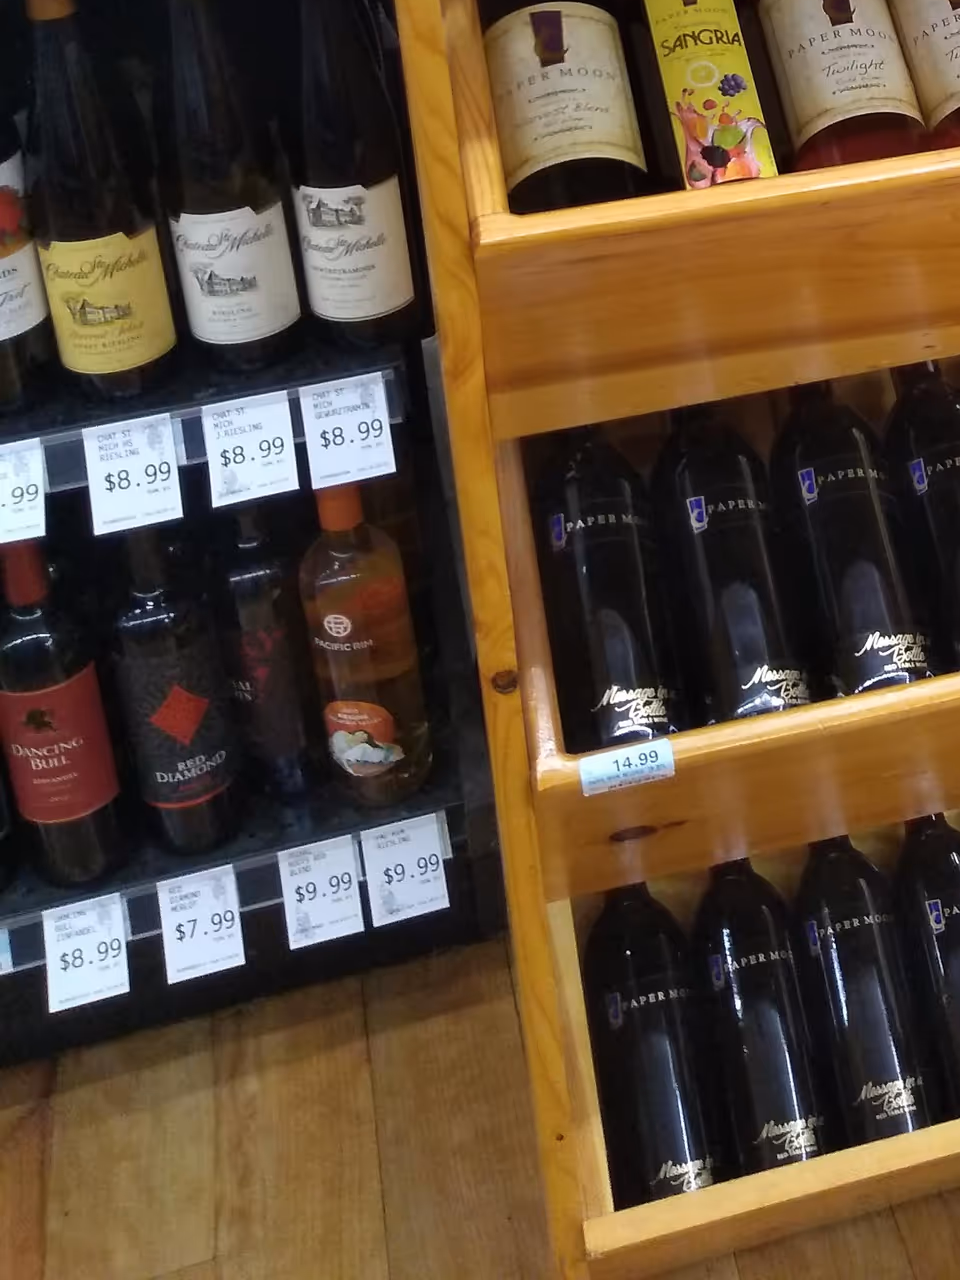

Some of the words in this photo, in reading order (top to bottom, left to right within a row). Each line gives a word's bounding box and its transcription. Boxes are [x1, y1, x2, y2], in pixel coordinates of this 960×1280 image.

[660, 28, 743, 58] SANGRIA
[787, 30, 842, 59] PAPER
[822, 59, 886, 78] Twilight
[176, 233, 217, 252] Chateau
[227, 223, 275, 252] Michelle
[343, 233, 388, 258] Michelle
[313, 401, 333, 410] MICH
[213, 421, 234, 431] MICH
[319, 418, 384, 450] $8.99
[100, 448, 140, 462] RIESLING
[220, 436, 285, 468] $8.99
[104, 461, 171, 493] $8.99
[816, 468, 865, 486] PAPER
[708, 499, 756, 515] PAPER
[566, 513, 617, 532] PAPER
[314, 637, 351, 651] PACIFIC
[353, 639, 374, 650] RIM
[854, 631, 914, 657] Message
[879, 645, 926, 663] Bottle
[591, 685, 656, 712] Message
[615, 699, 668, 719] Bottle
[11, 738, 84, 758] DANCING
[31, 756, 71, 771] BULL
[155, 750, 227, 783] DIAMOND
[177, 754, 207, 771] RED
[612, 750, 659, 772] 14.99
[383, 852, 440, 886] $9.99
[295, 871, 353, 904] $9.99
[175, 909, 235, 942] $7.99
[817, 919, 861, 938] PAPER
[60, 937, 121, 971] $8.99
